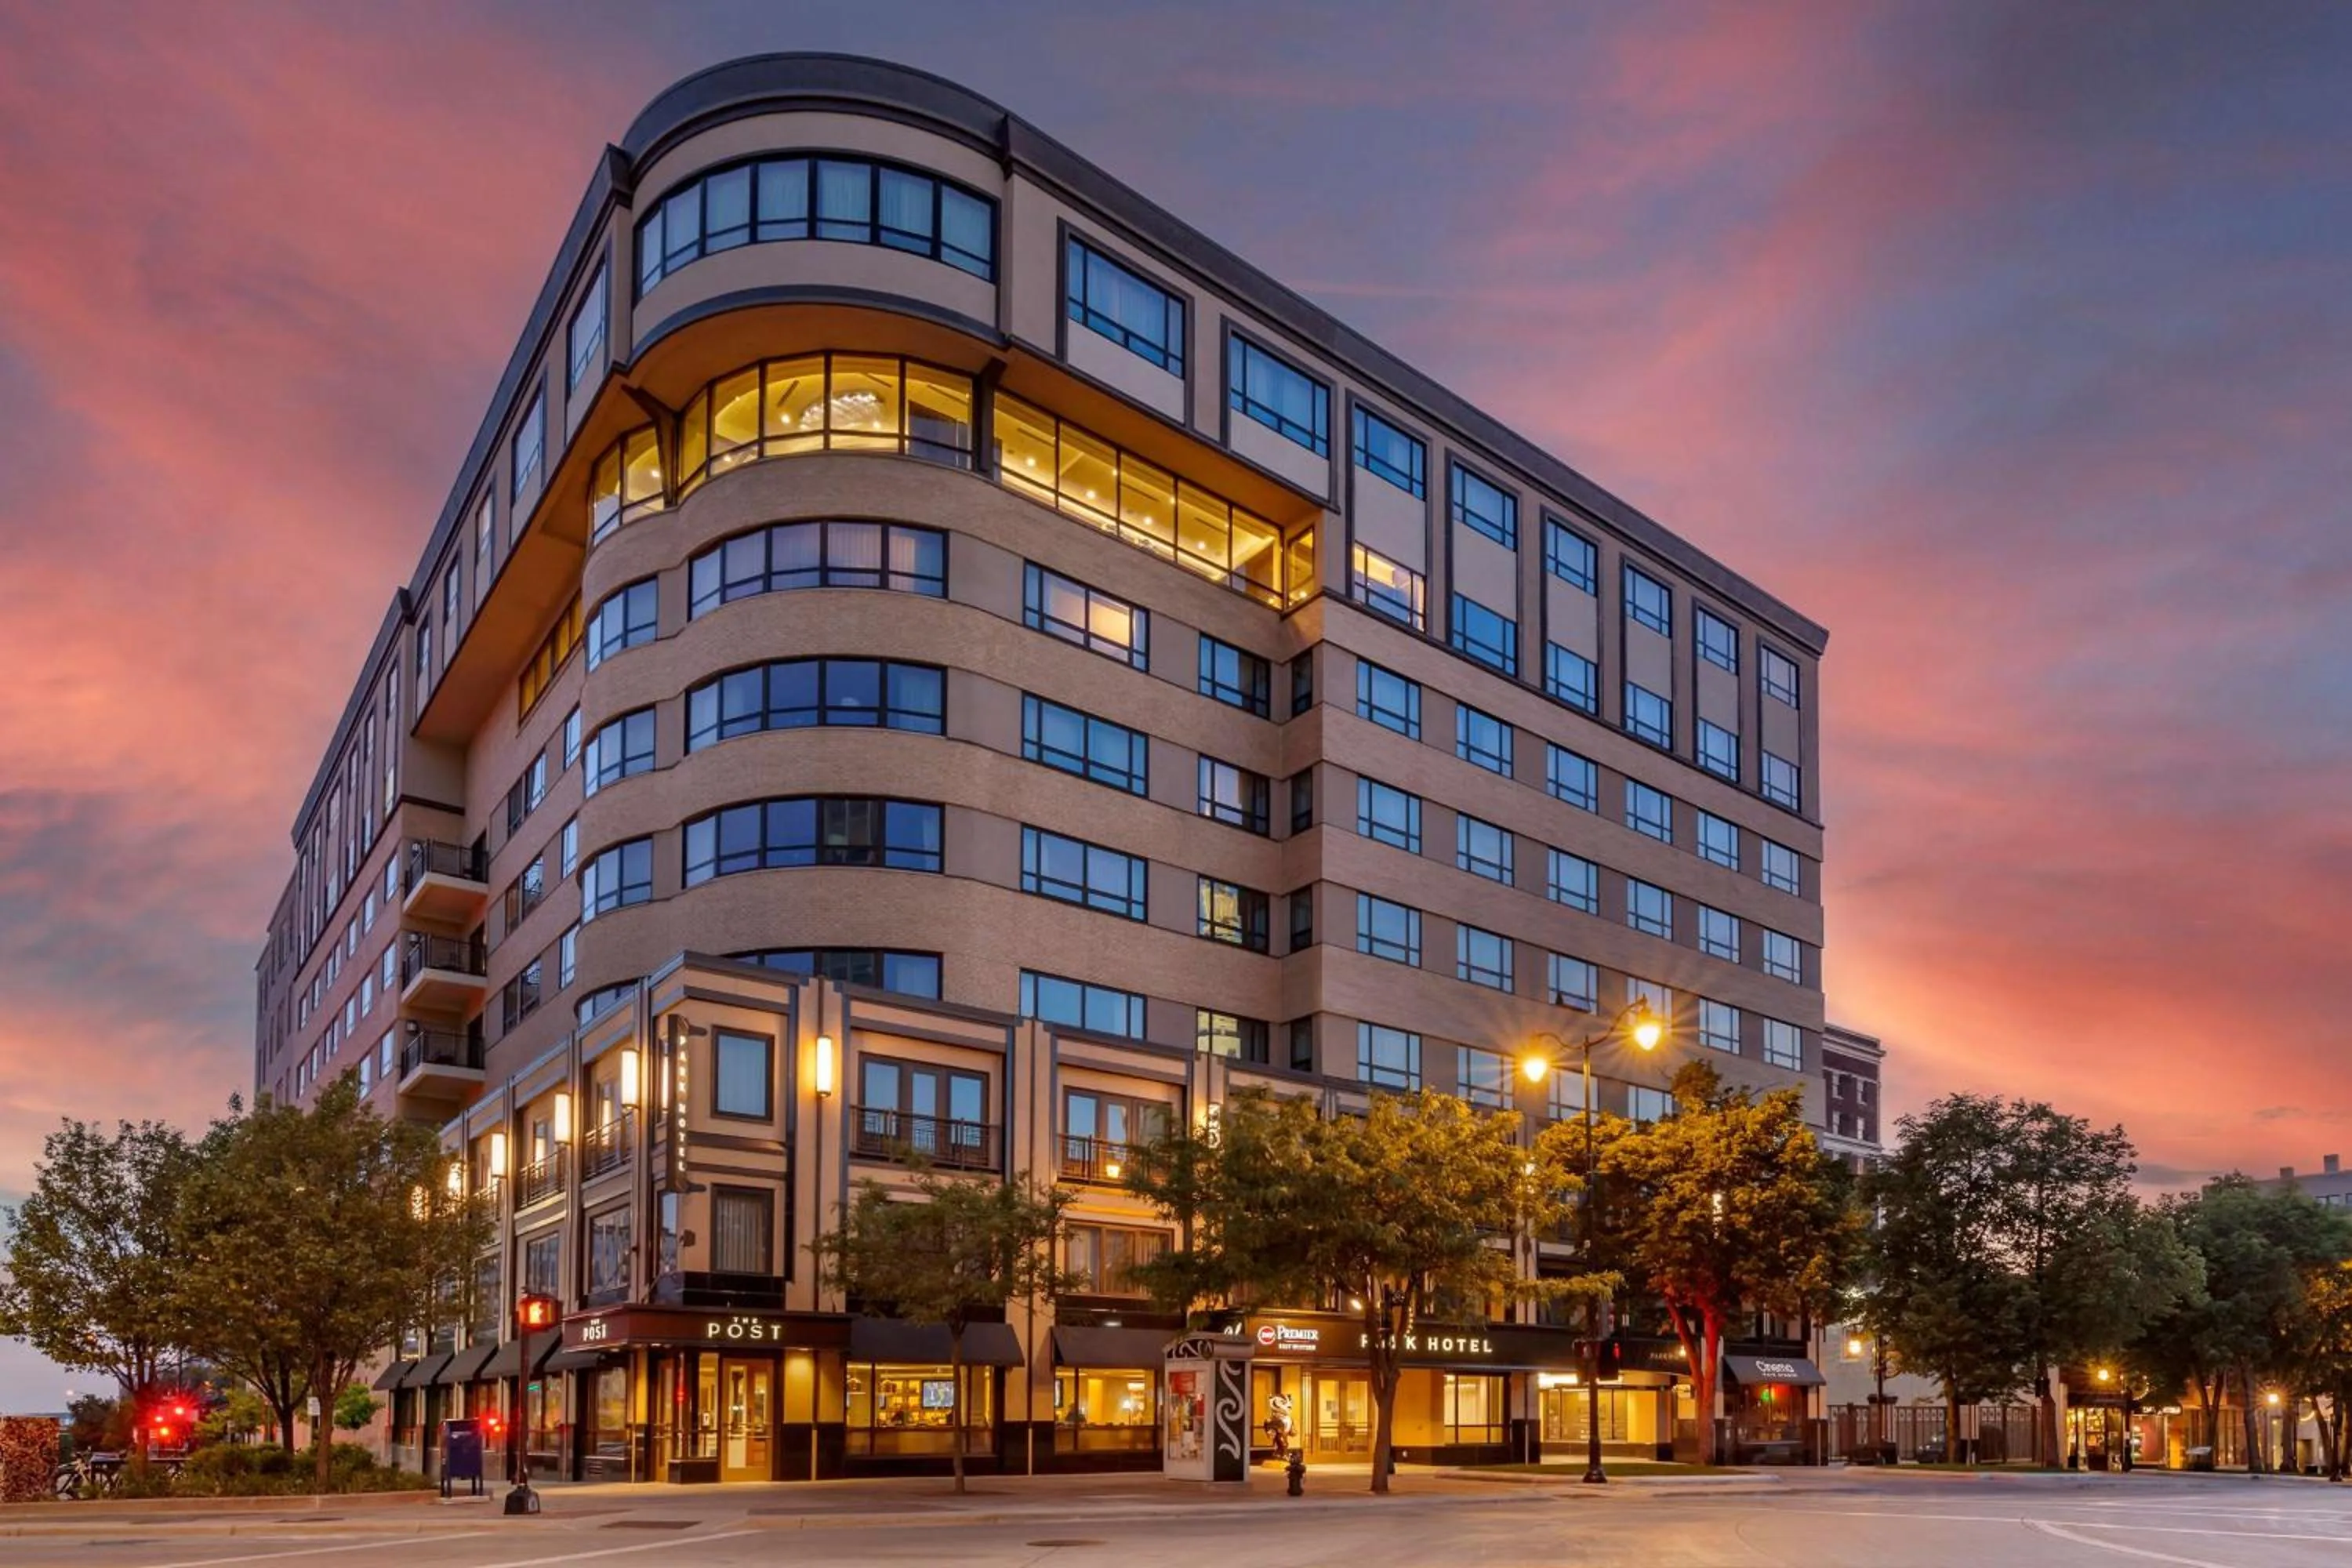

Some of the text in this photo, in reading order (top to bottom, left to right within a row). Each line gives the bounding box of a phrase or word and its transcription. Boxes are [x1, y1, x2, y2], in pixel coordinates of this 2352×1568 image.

[583, 1323, 607, 1341] POST
[707, 1323, 782, 1340] POST
[1428, 1336, 1493, 1352] HOTEL
